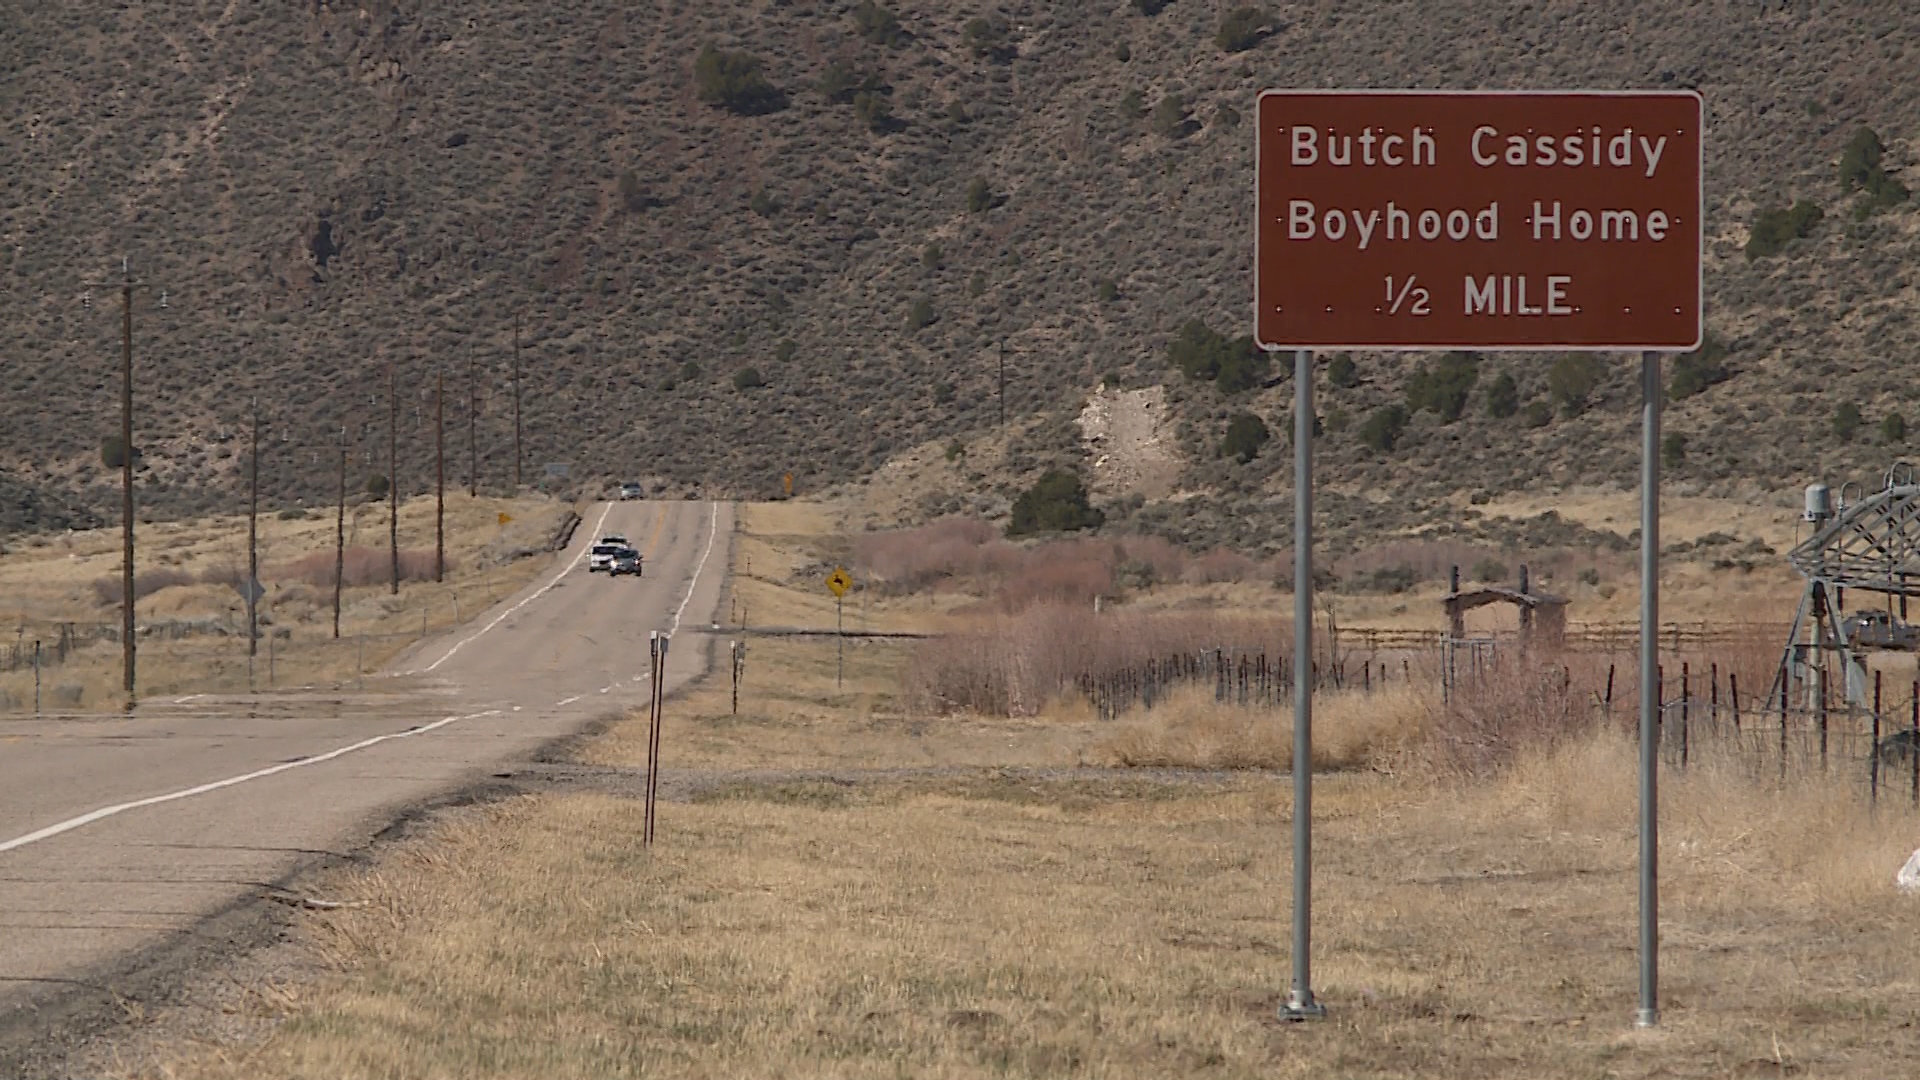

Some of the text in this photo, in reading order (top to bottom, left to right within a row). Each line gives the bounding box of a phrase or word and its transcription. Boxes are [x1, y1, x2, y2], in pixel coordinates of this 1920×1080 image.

[1290, 126, 1667, 177] Butch Cassidy
[1288, 200, 1671, 249] Boyhood Home
[1464, 275, 1573, 315] MILE
